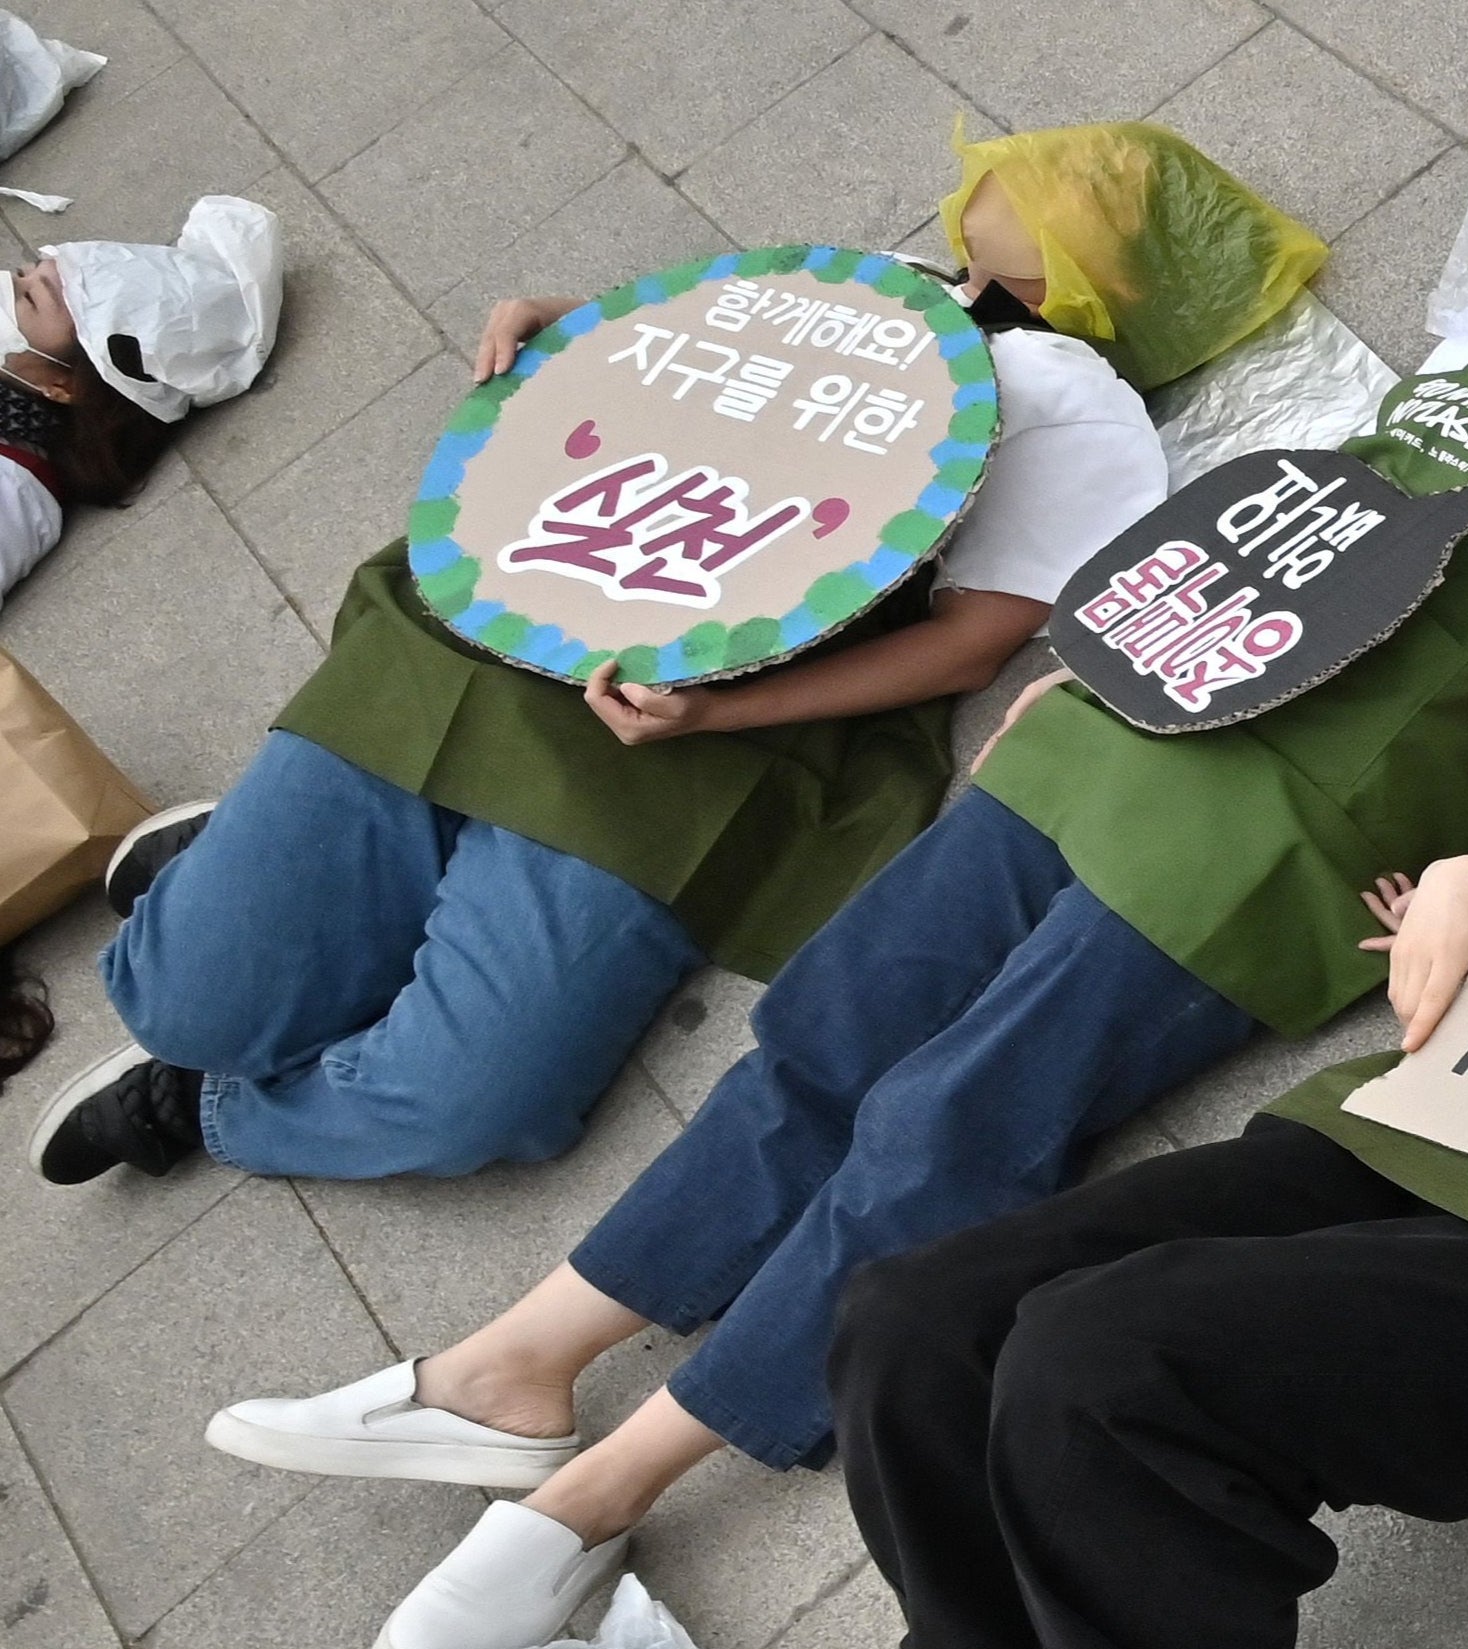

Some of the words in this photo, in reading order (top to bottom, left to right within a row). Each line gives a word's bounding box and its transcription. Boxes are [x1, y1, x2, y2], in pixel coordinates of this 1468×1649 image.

[608, 322, 794, 422] 지구를
[792, 374, 925, 455] 위한
[705, 280, 936, 371] 함께해요!
[1215, 458, 1387, 590] 없나요
